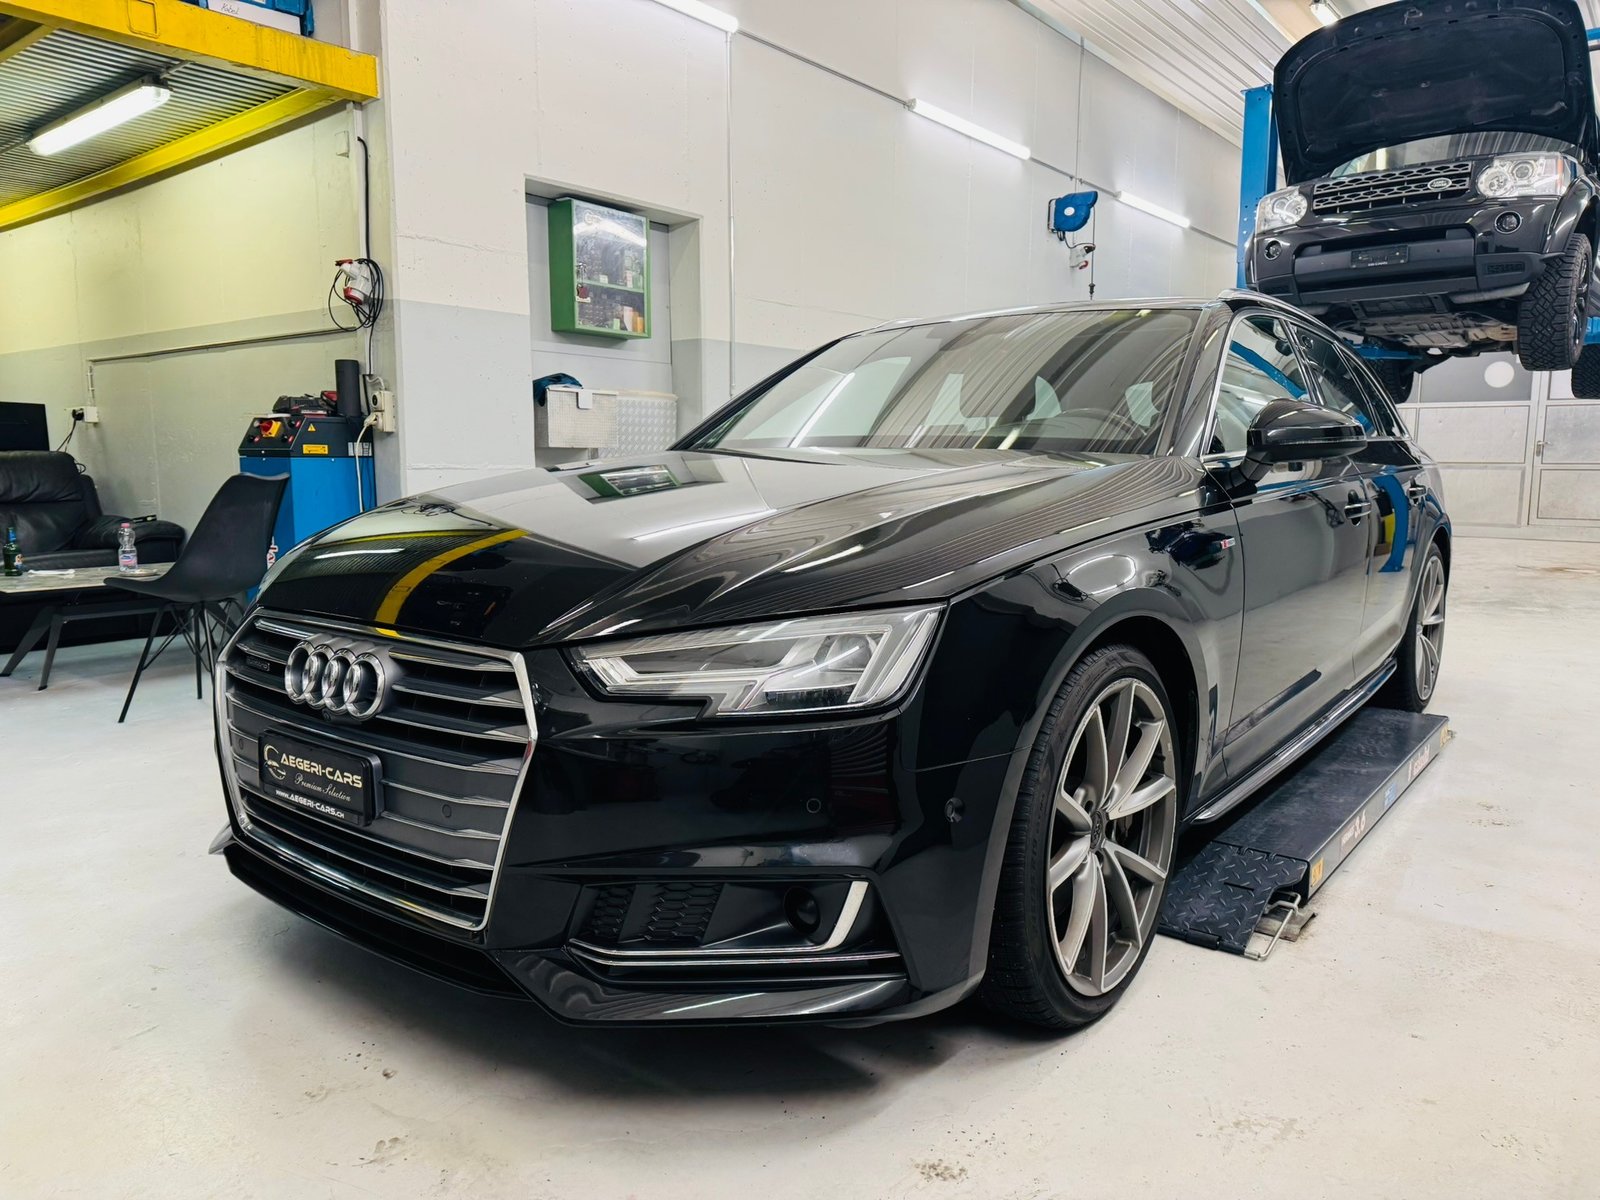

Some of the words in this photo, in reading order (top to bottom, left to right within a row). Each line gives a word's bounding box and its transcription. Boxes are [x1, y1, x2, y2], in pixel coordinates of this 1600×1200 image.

[280, 753, 363, 788] AEGERI-CARS
[295, 773, 322, 793] Premium
[322, 783, 352, 802] Selection
